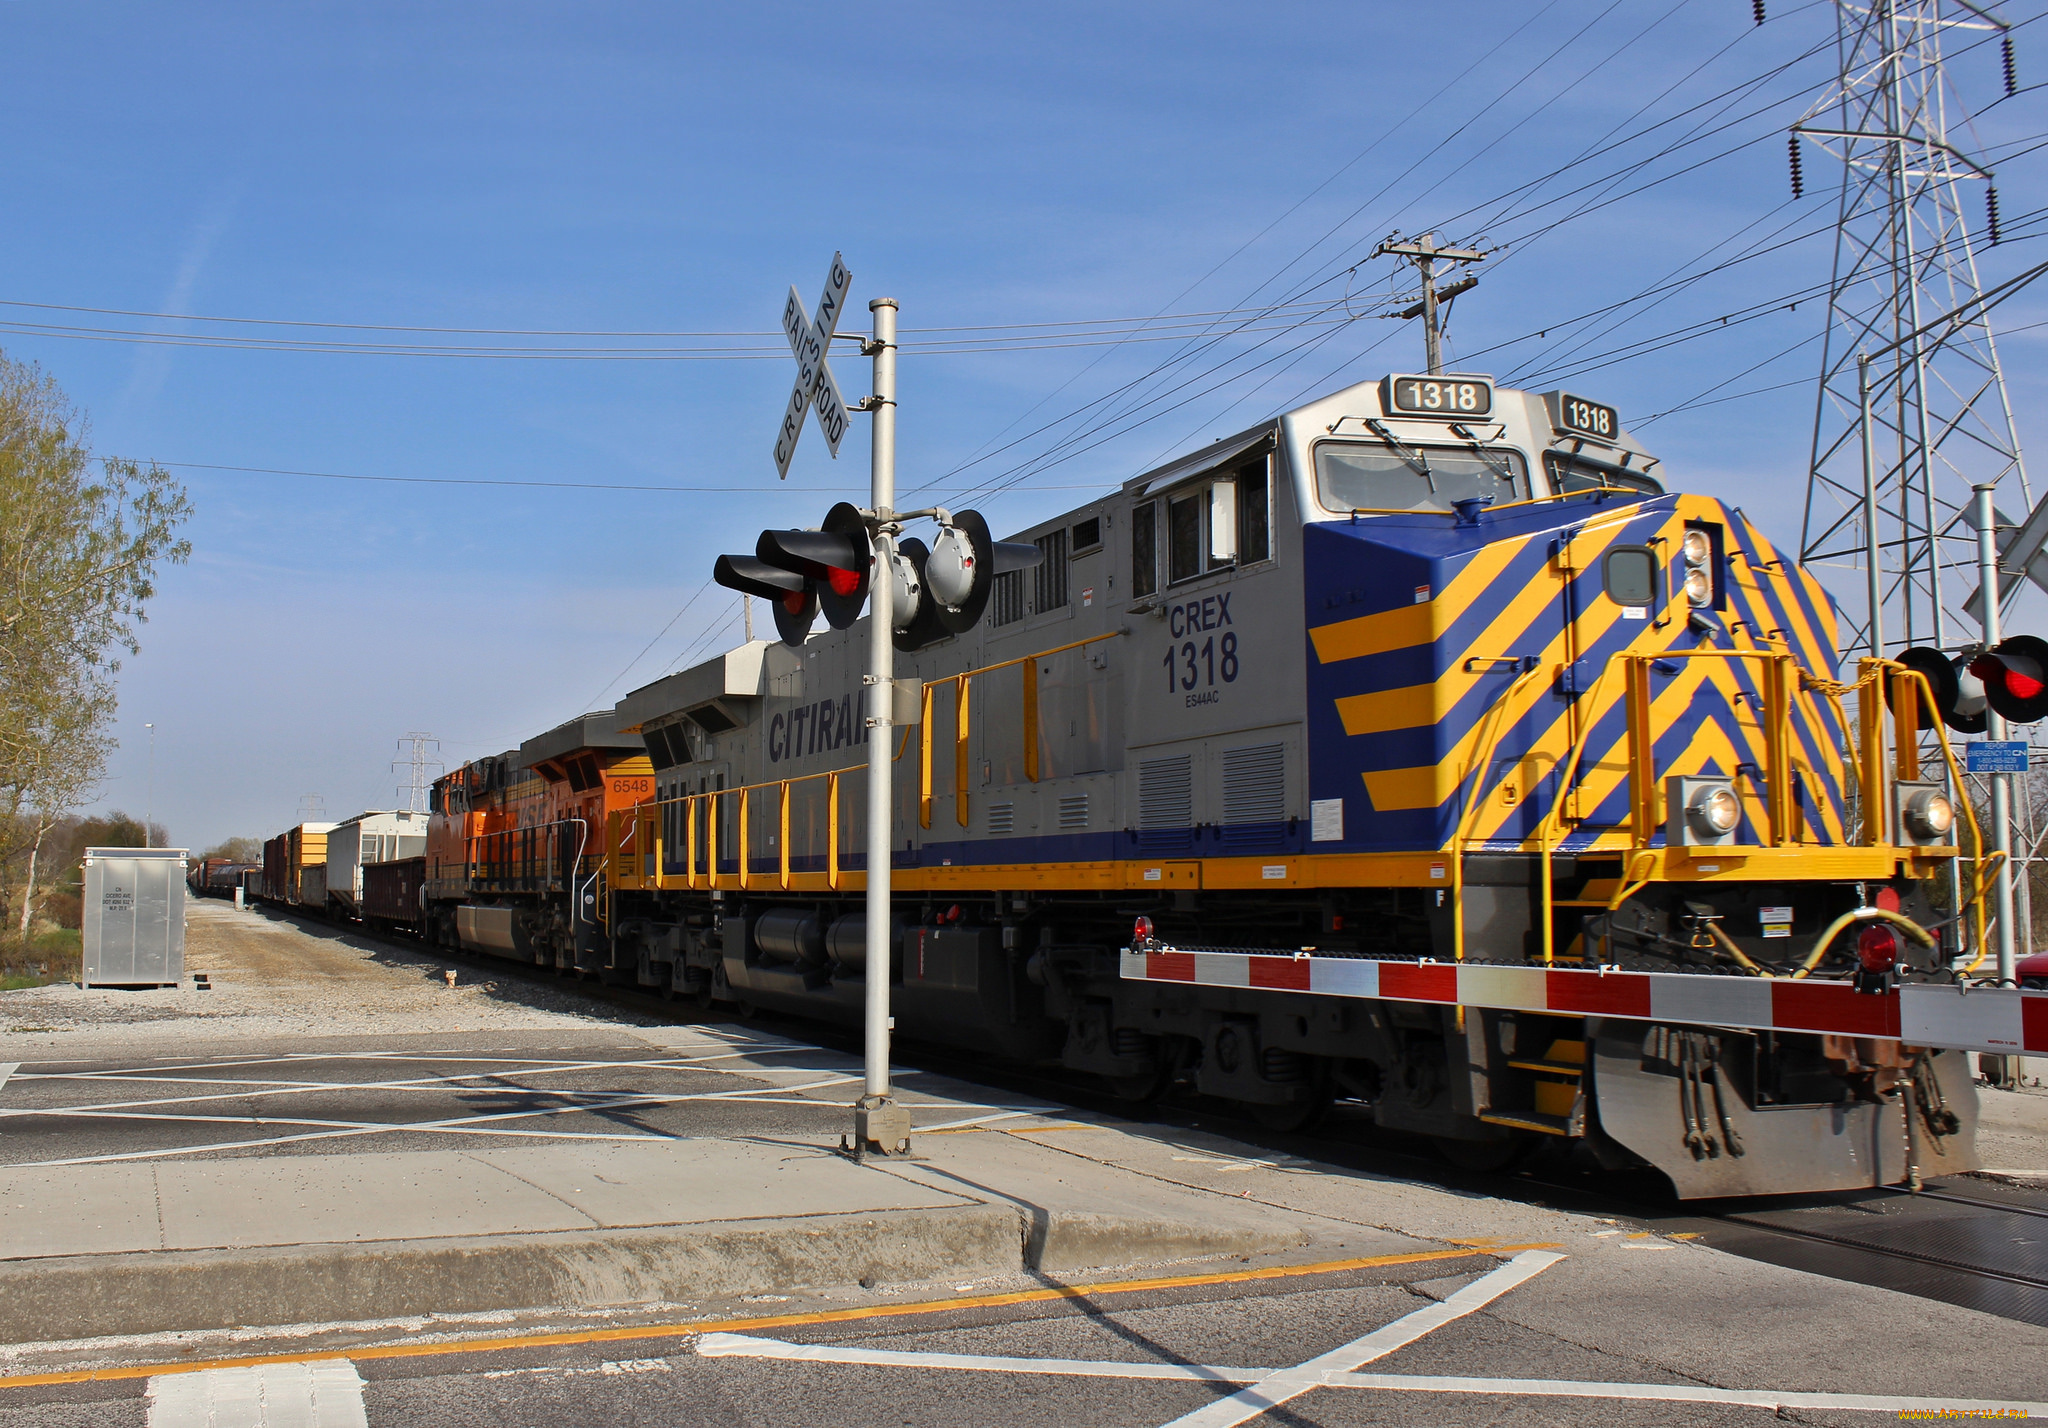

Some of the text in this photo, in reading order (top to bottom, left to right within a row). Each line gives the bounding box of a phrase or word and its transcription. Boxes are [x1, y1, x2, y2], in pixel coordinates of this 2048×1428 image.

[777, 264, 845, 465] CROSSING
[784, 297, 843, 444] RAIL ROAD
[1408, 382, 1477, 411] 1318
[1569, 401, 1611, 434] 1318
[1170, 591, 1233, 639] CREX
[1163, 631, 1239, 694] 1318
[1185, 690, 1219, 708] ES44AC
[613, 779, 649, 793] 6548
